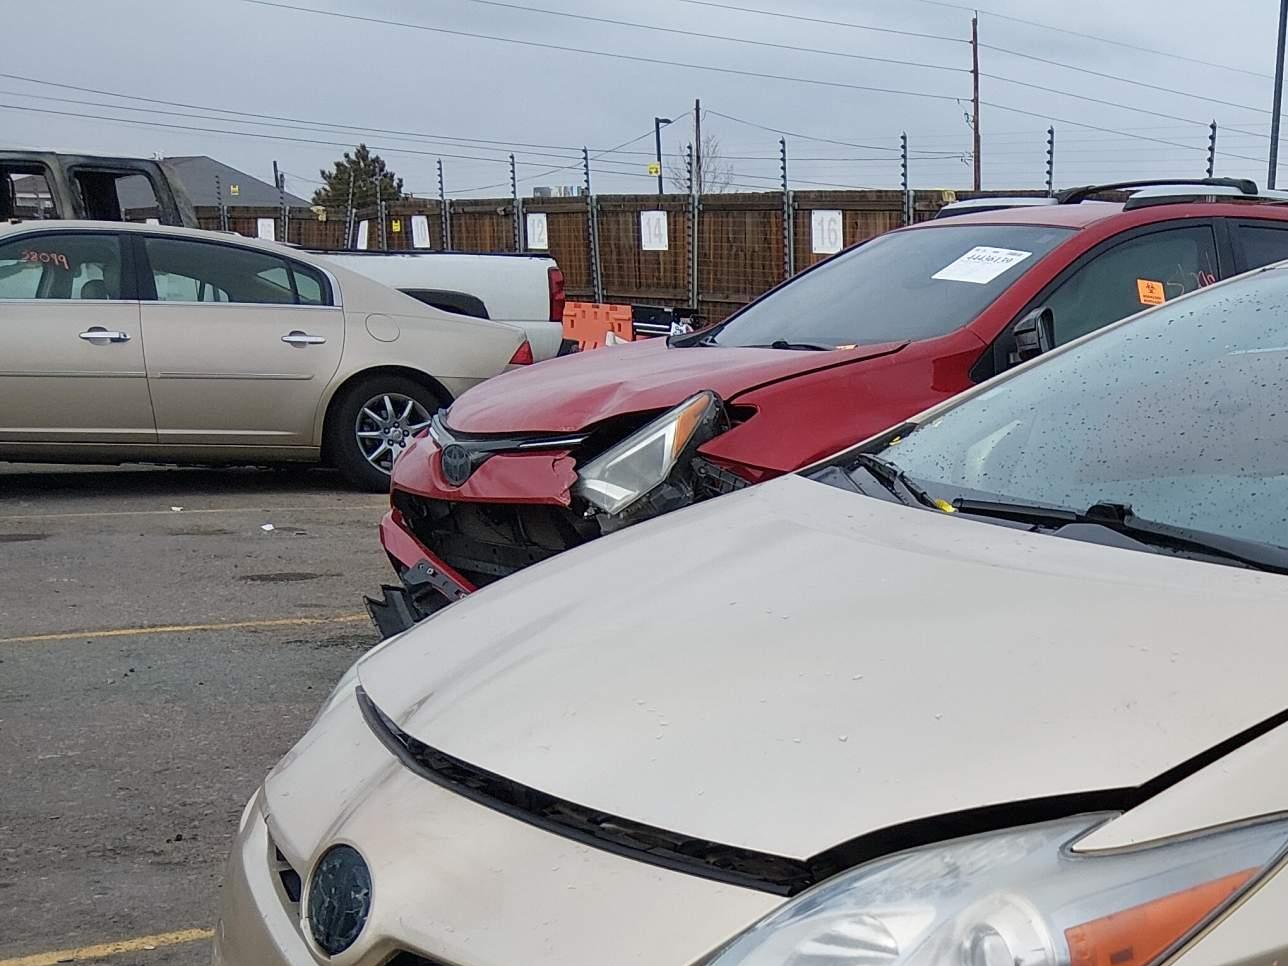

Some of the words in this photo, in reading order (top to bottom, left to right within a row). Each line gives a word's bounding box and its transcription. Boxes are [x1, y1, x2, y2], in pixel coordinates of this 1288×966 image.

[530, 217, 546, 244] 12
[647, 217, 664, 244] 14
[817, 215, 838, 246] 16
